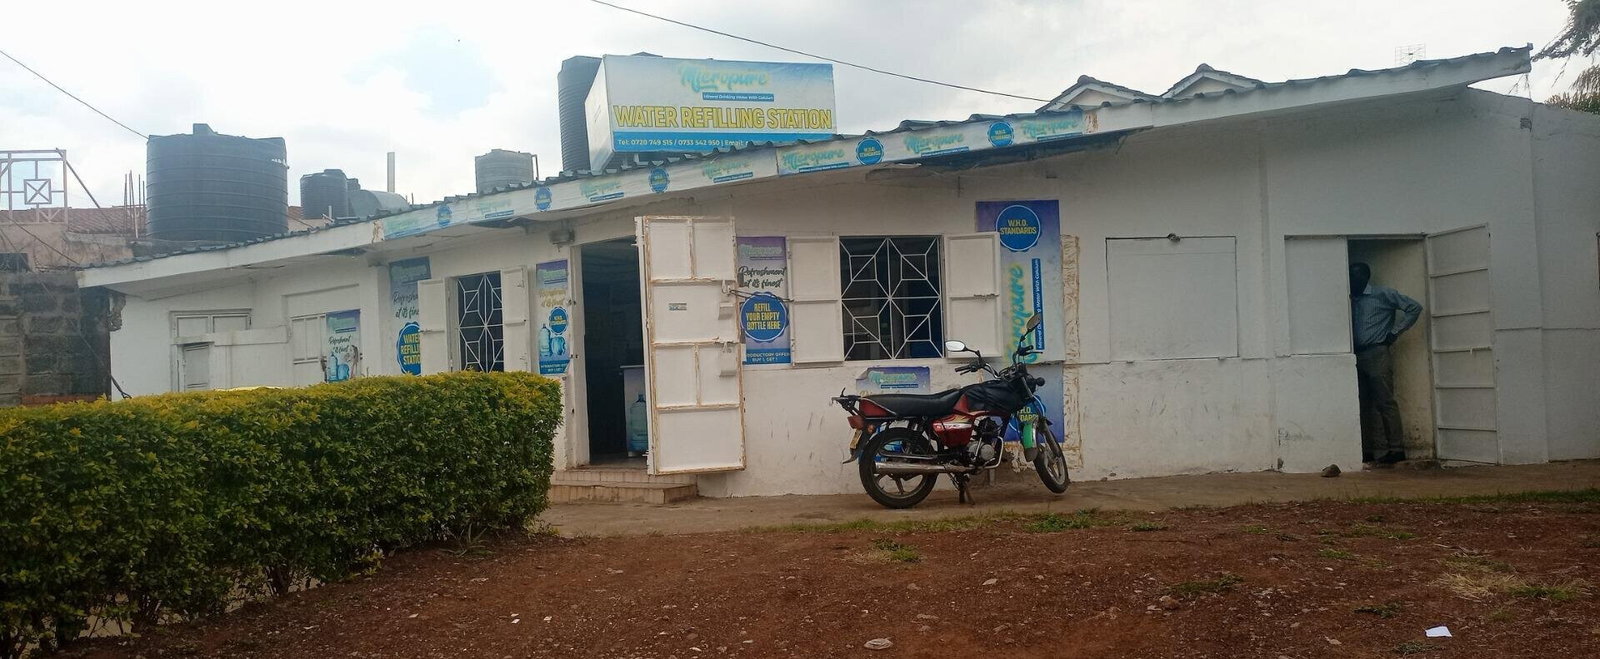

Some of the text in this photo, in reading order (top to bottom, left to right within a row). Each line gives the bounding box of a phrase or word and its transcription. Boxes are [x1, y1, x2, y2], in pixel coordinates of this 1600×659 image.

[613, 105, 832, 129] WATER REFILLING STATION
[1007, 219, 1028, 227] W.H.O.
[1000, 226, 1037, 235] STANDARDS
[738, 266, 787, 277] Refreshment
[761, 278, 783, 289] finest
[754, 303, 770, 311] REFILL
[746, 312, 779, 321] YOUR EMPTY
[747, 321, 780, 330] BOTTLE HERE
